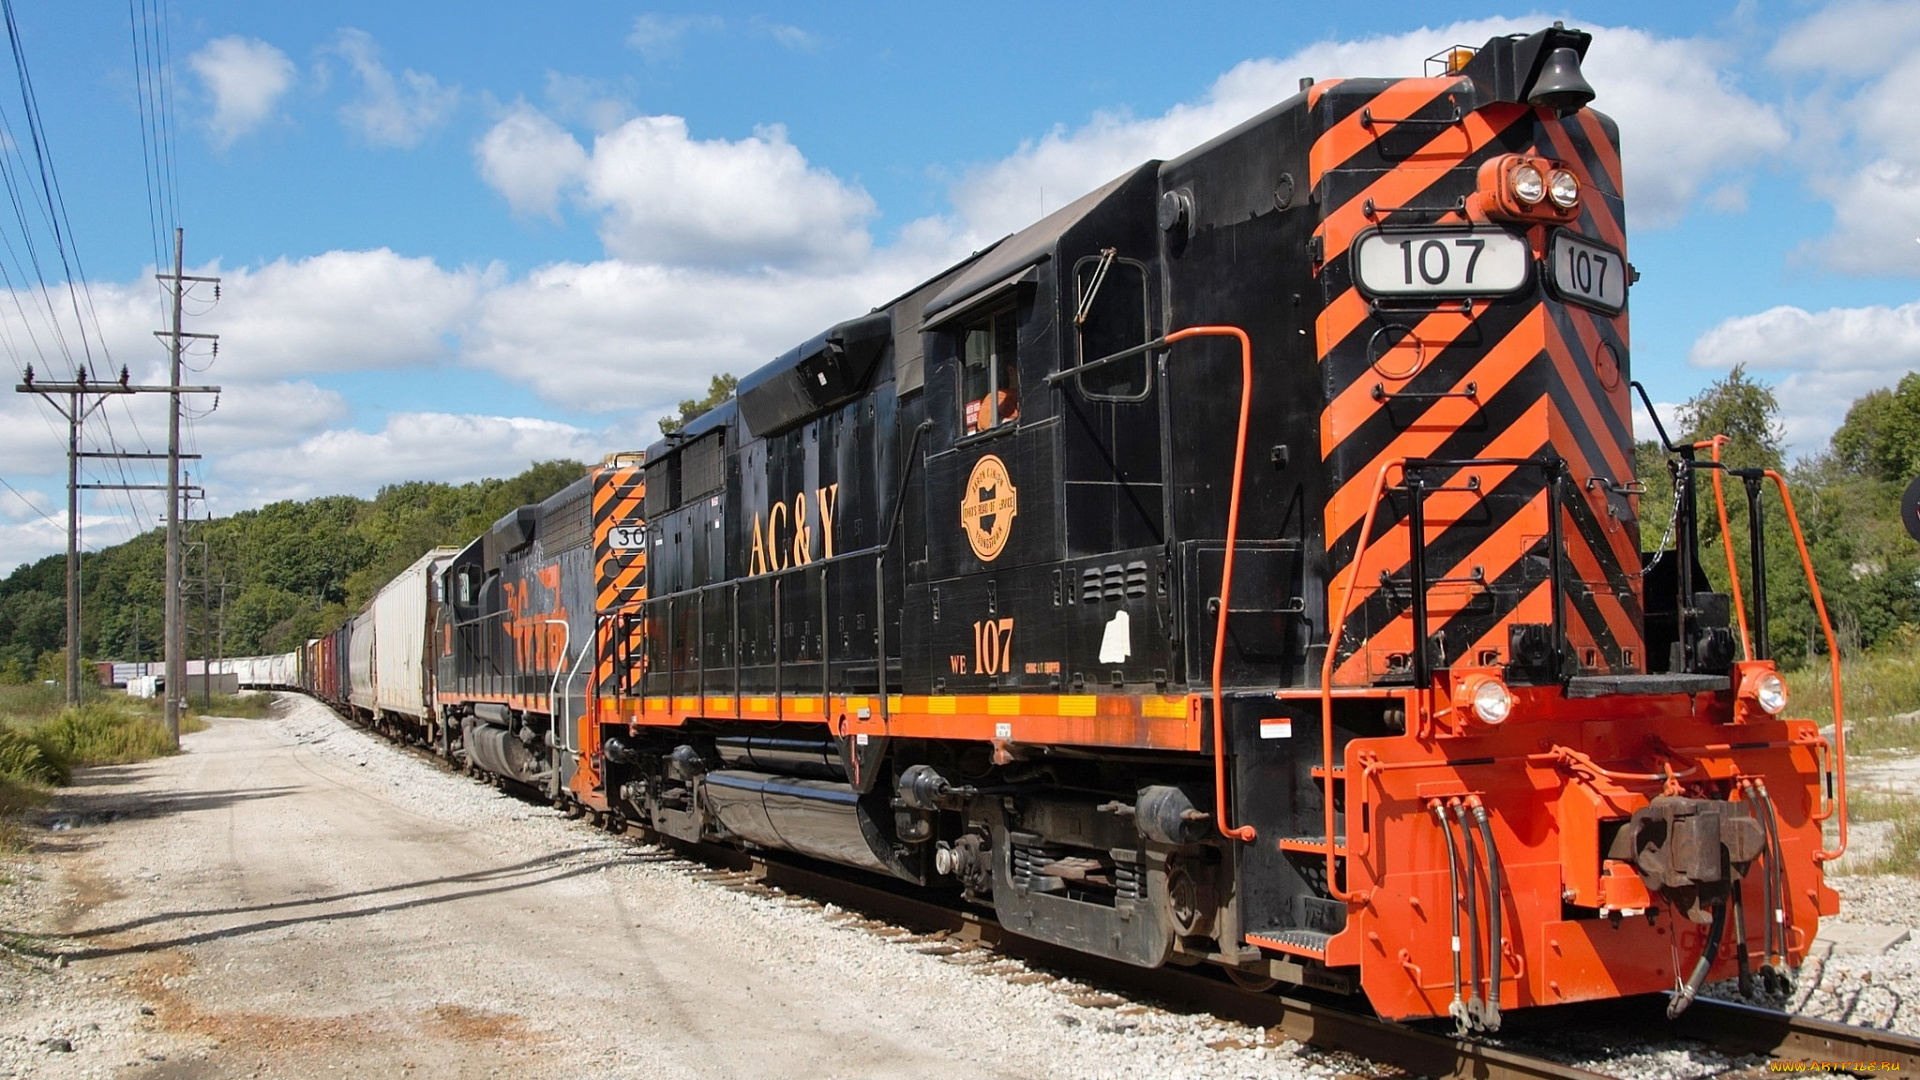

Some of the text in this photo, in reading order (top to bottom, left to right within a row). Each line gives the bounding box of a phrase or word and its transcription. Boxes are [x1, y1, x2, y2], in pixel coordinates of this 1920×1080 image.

[1400, 239, 1485, 285] 107
[1568, 246, 1607, 297] 107
[618, 528, 645, 545] 30
[749, 483, 838, 577] AC&Y
[950, 655, 967, 674] WE
[974, 618, 1014, 676] 107
[1193, 699, 1198, 721] F
